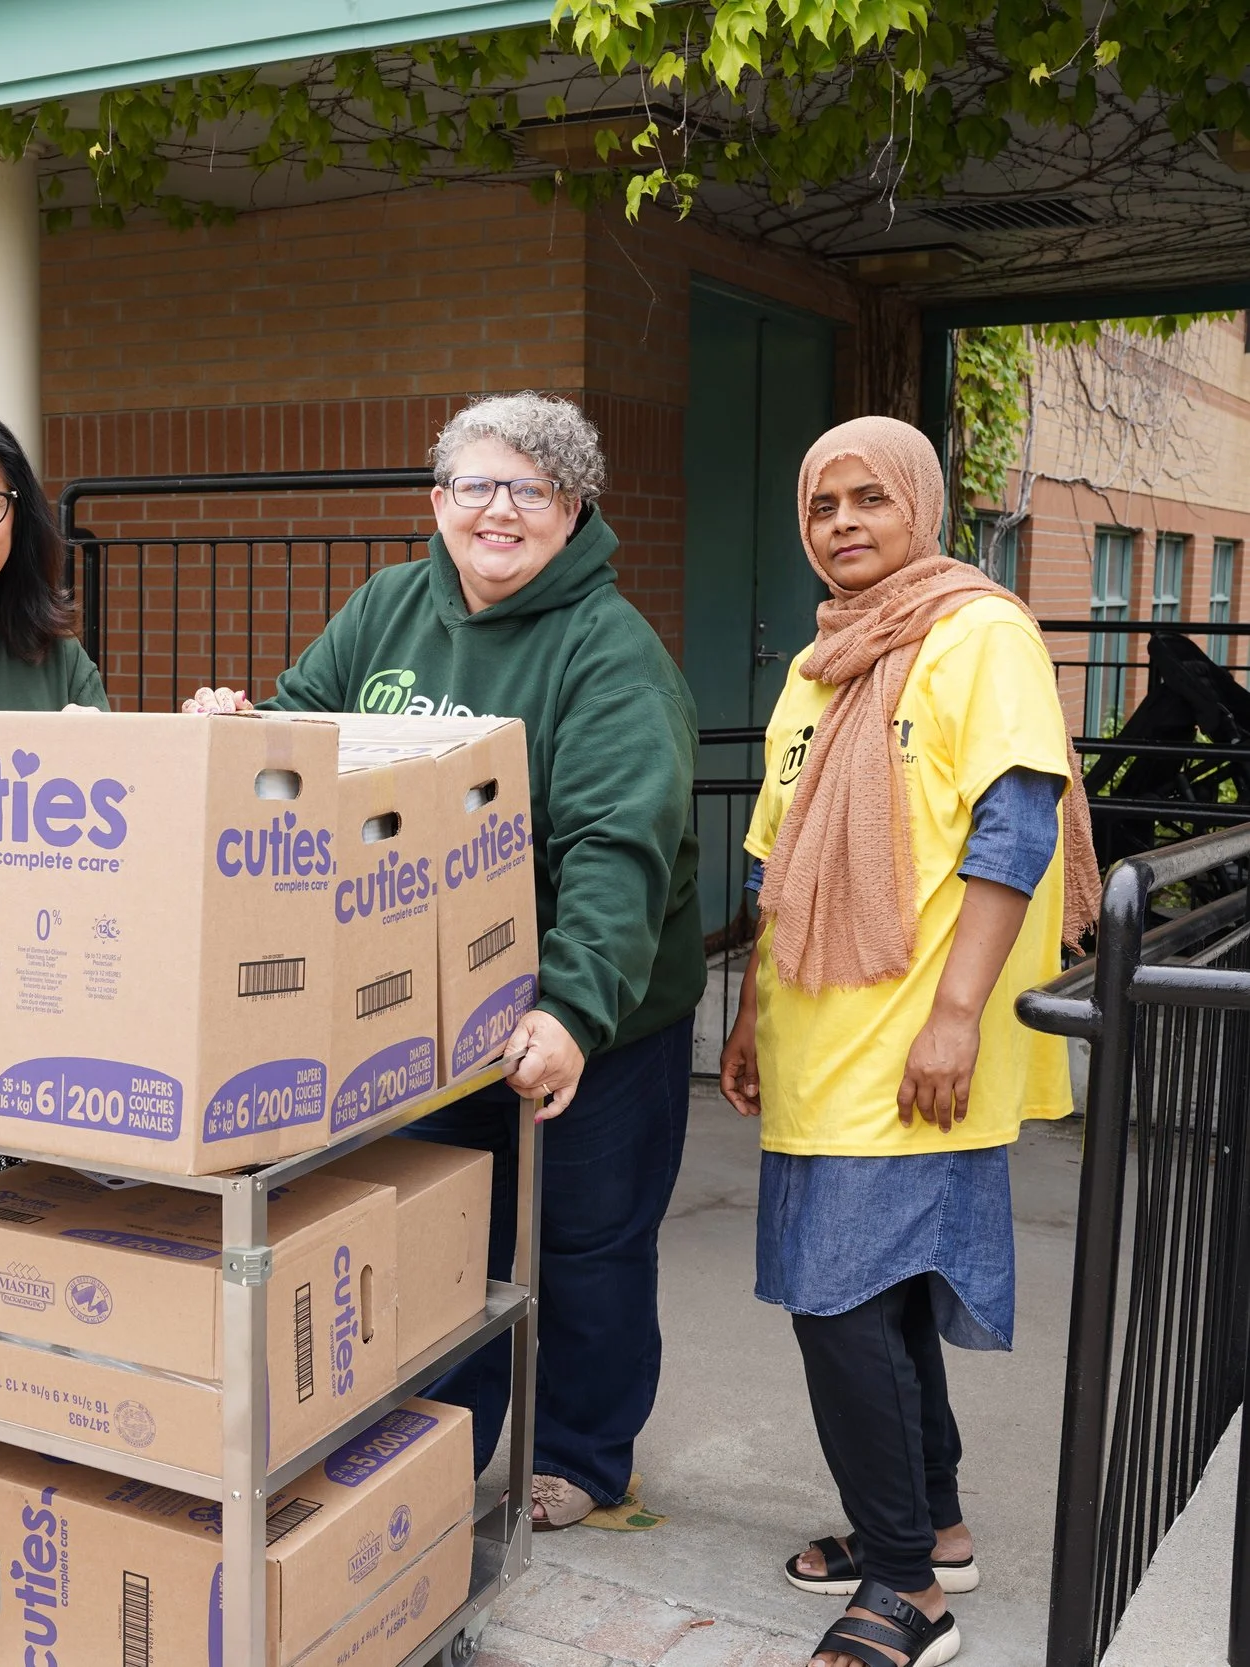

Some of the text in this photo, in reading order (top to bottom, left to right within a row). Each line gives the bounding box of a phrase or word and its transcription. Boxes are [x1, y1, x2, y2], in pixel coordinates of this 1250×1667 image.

[216, 811, 332, 878] cuties
[445, 812, 525, 890] cuties
[78, 856, 120, 873] care
[486, 853, 526, 883] complete care
[274, 880, 328, 893] complete care
[334, 850, 430, 925] cuties
[382, 902, 429, 925] complete care
[98, 924, 108, 934] 12
[475, 1024, 485, 1053] 3
[489, 1004, 514, 1045] 200
[409, 1042, 431, 1061] DIAPERS
[297, 1067, 322, 1084] DIAPERS
[409, 1057, 431, 1076] COUCHES
[2, 1077, 14, 1093] 35
[21, 1079, 32, 1095] lb
[131, 1078, 173, 1098] DIAPERS
[295, 1083, 322, 1101] COUCHES
[351, 1089, 358, 1102] lb
[359, 1066, 407, 1113] 3 200
[17, 1096, 33, 1115] kg)
[36, 1081, 125, 1126] 6 200
[129, 1095, 174, 1115] COUCHES
[212, 1101, 221, 1116] 35
[226, 1099, 234, 1114] lb
[236, 1086, 293, 1129] 6 200
[294, 1100, 321, 1117] PAÑALES
[128, 1112, 173, 1133] PAÑALES
[222, 1114, 234, 1134] kg)
[121, 1239, 170, 1254] 200
[334, 1245, 358, 1396] cuties
[6, 1378, 18, 1392] 13
[22, 1381, 28, 1392] x
[53, 1390, 59, 1402] 9
[63, 1392, 69, 1402] x
[95, 1400, 109, 1414] 16
[69, 1412, 110, 1433] 347493
[347, 1431, 409, 1467] 5 200
[61, 1518, 69, 1608] complete care
[351, 1541, 380, 1571] MASTER
[10, 1505, 58, 1667] cuties
